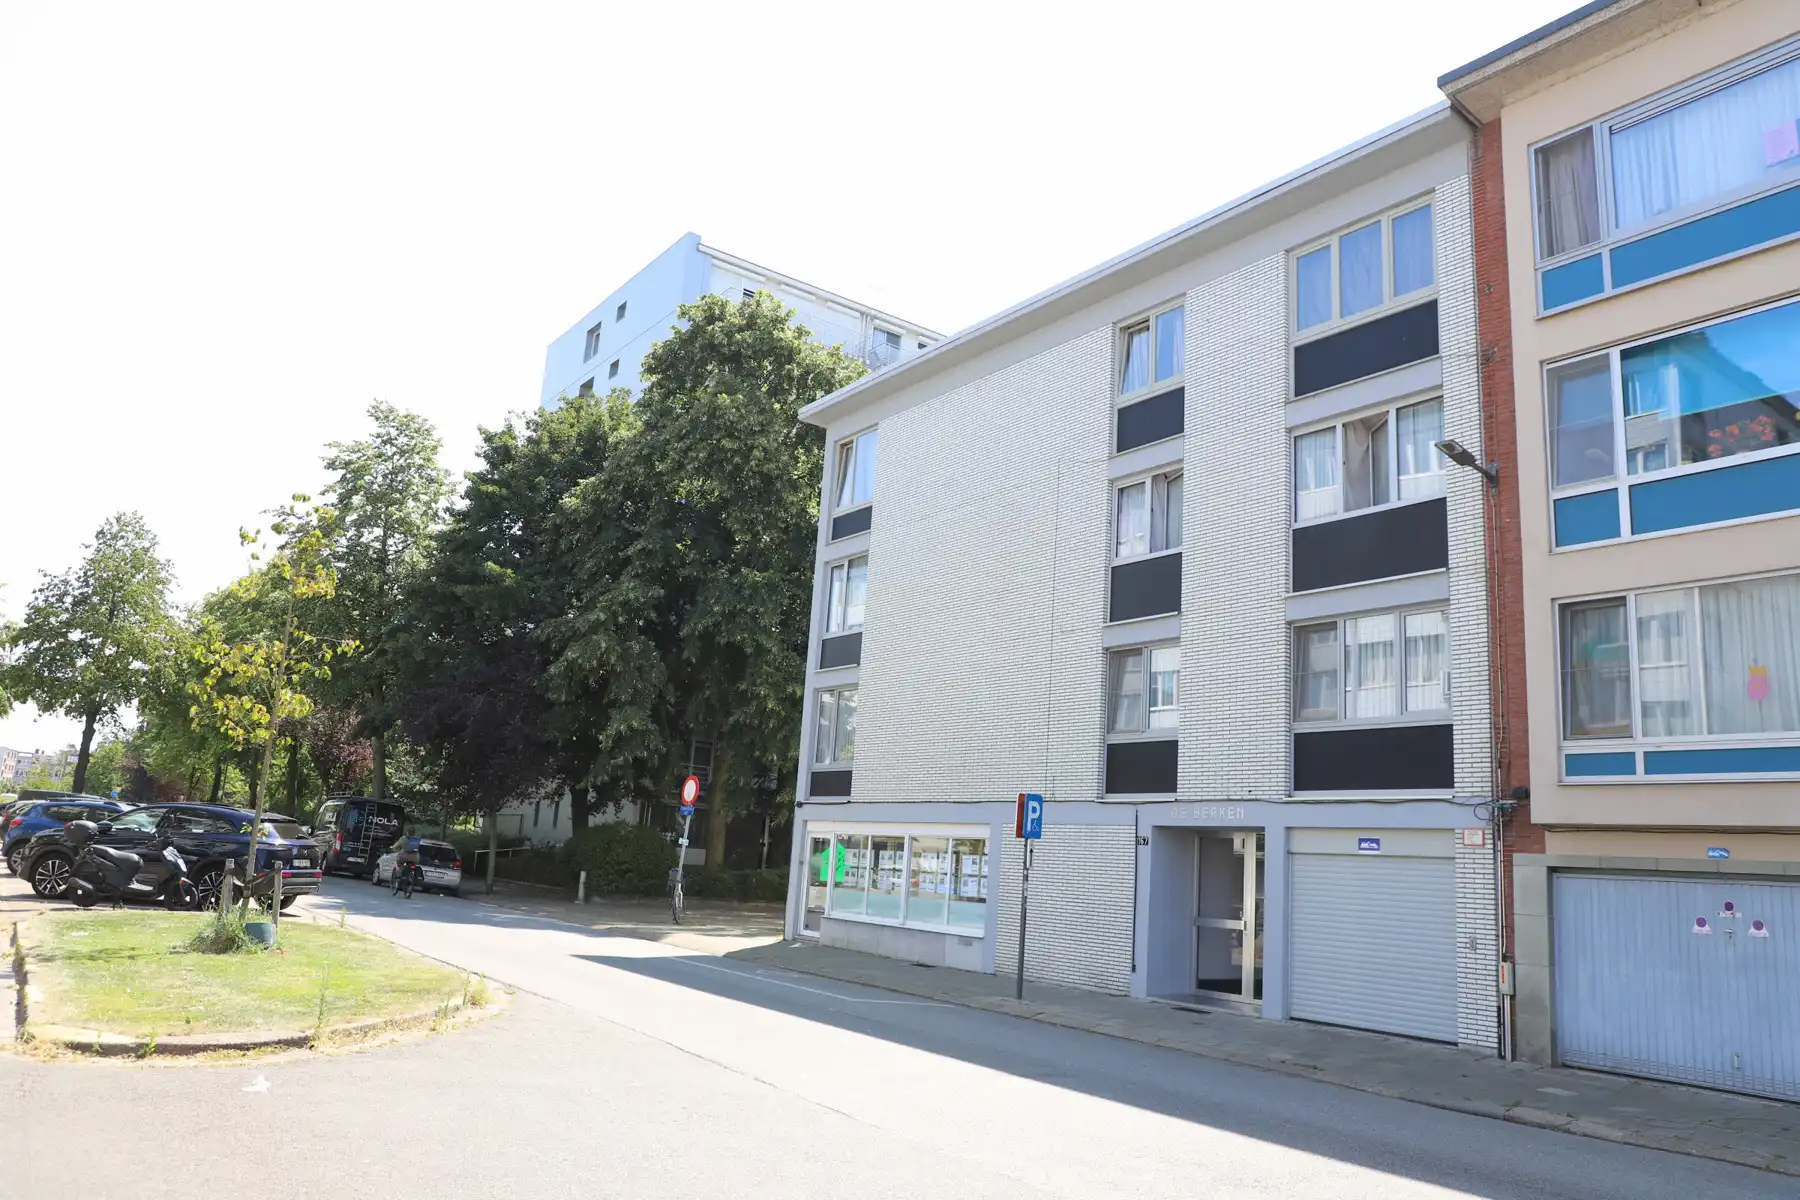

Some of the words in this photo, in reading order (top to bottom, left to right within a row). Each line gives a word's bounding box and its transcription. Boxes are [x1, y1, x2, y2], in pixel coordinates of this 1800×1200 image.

[1027, 800, 1040, 833] P
[1171, 807, 1187, 819] DE
[1193, 807, 1245, 819] BERKEN
[368, 815, 399, 827] NOLA
